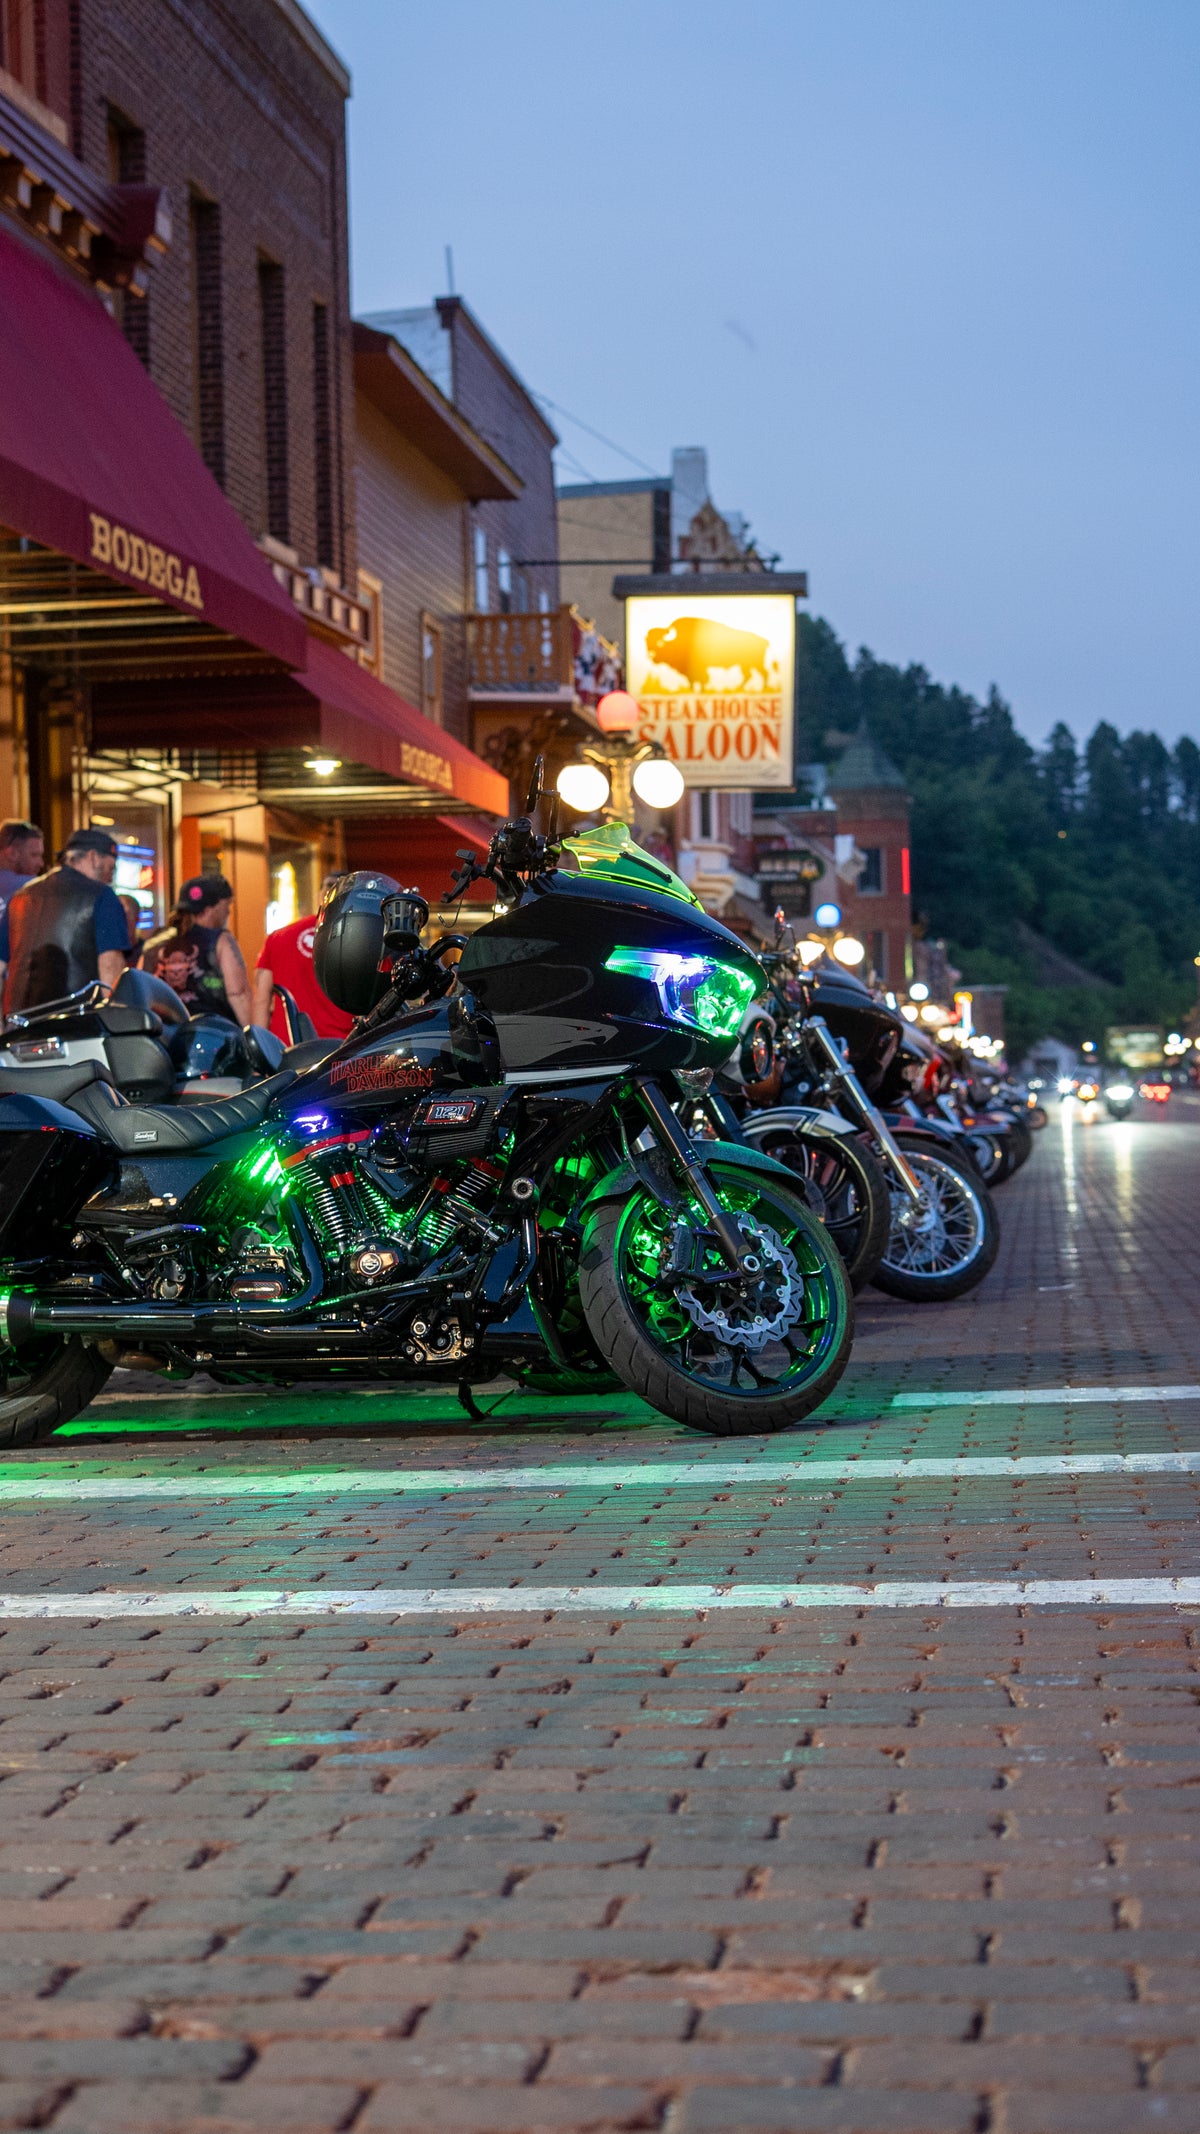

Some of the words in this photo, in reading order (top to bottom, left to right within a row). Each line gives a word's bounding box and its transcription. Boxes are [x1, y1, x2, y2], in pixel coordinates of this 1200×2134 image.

[89, 512, 204, 610] BODEGA
[638, 699, 782, 720] STEAKHOUSE
[638, 723, 782, 761] SALOON
[400, 742, 453, 790] BODEGA
[347, 1069, 433, 1093] DAVIDSON
[435, 1105, 466, 1117] 121
